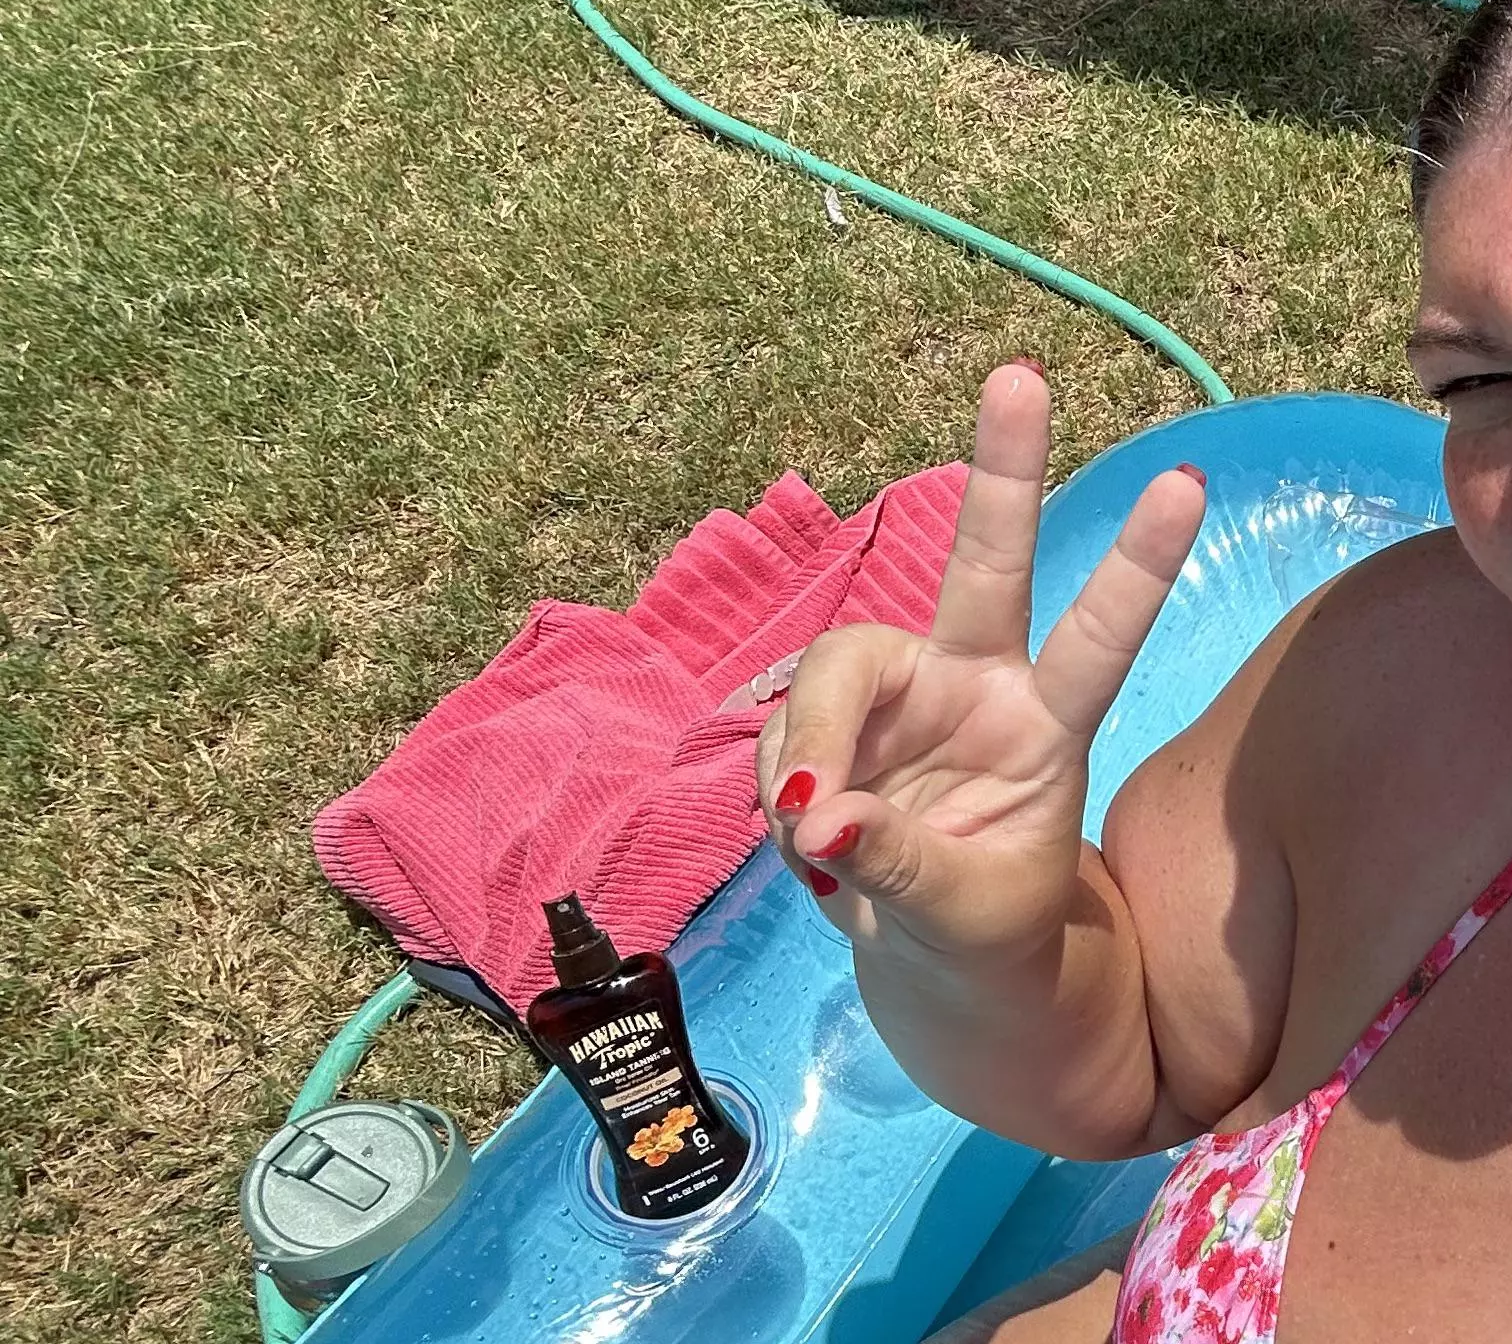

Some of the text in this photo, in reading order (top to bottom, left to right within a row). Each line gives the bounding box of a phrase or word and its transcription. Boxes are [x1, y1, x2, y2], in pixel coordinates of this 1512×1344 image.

[568, 1011, 664, 1064] HAWAIIAN
[589, 1034, 653, 1070] Tropic
[588, 1067, 627, 1087] ISLAND
[692, 1127, 710, 1148] 6
